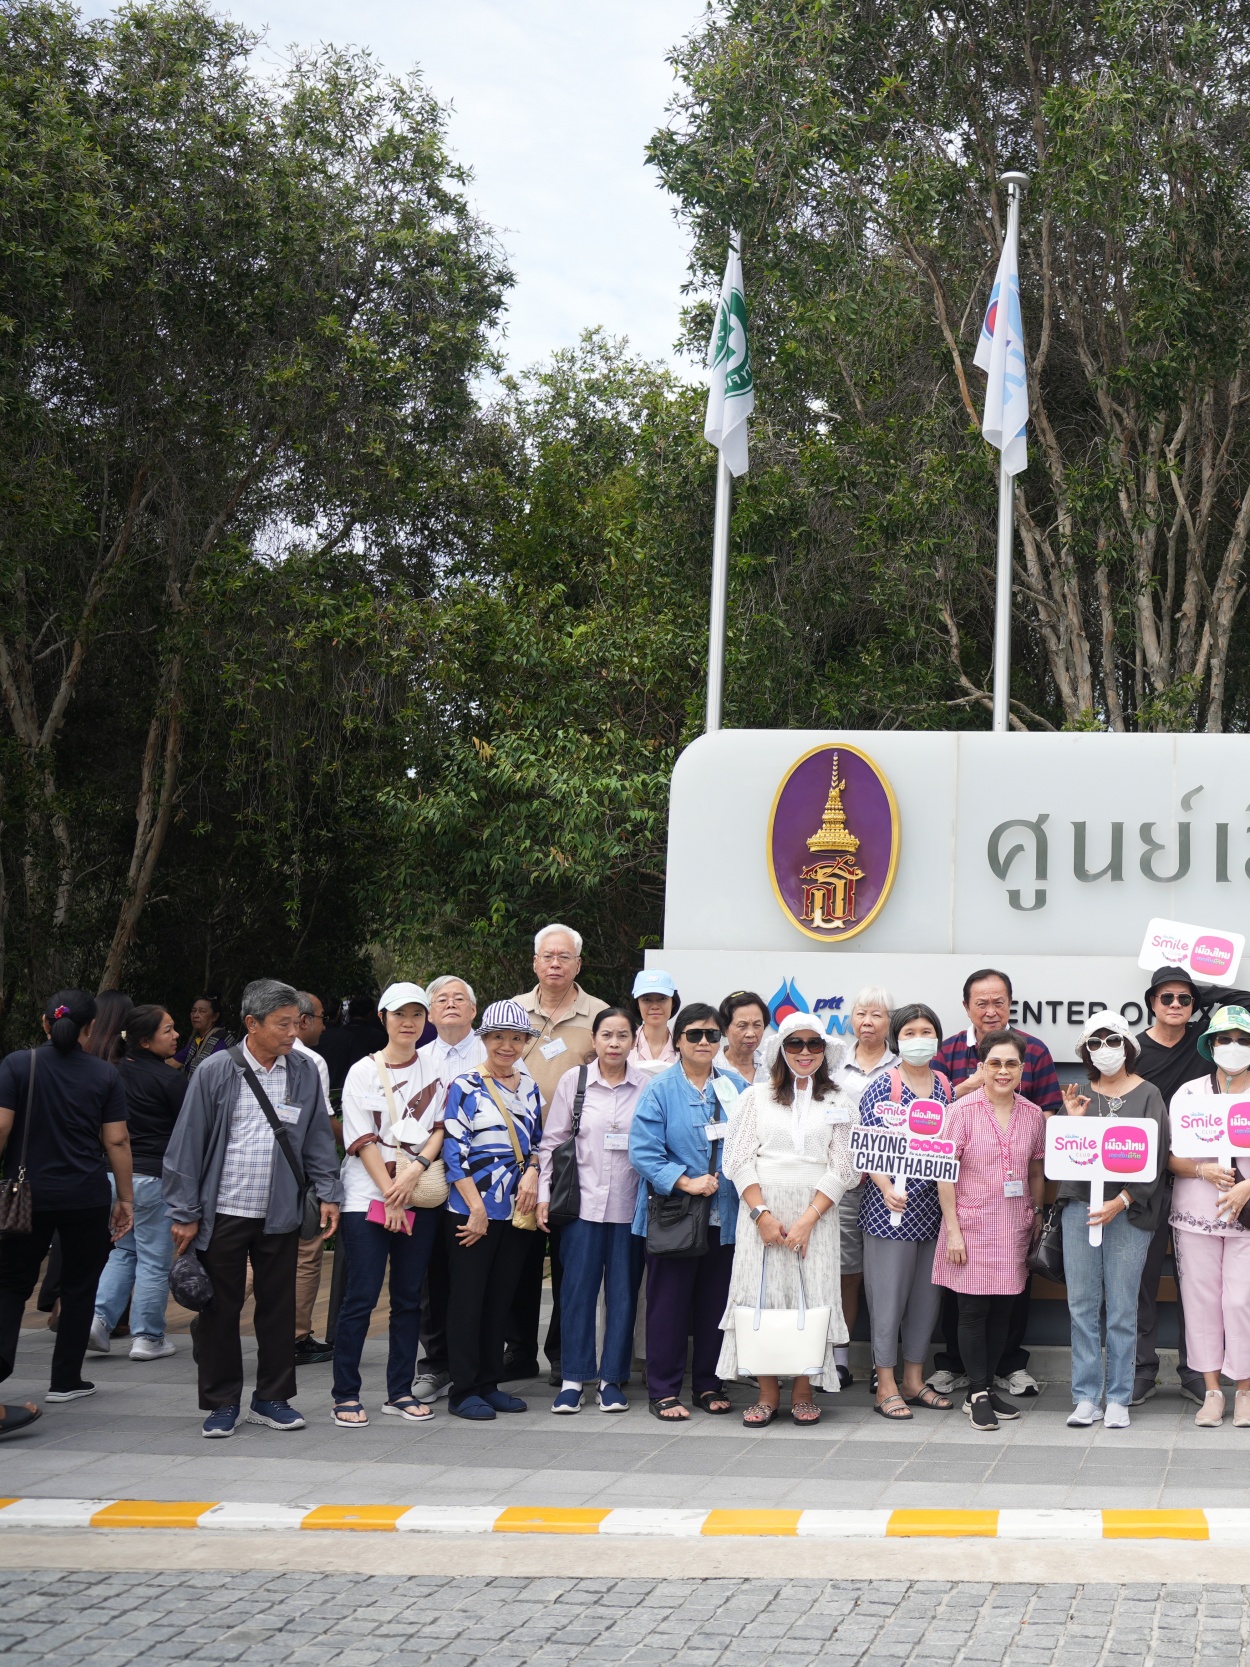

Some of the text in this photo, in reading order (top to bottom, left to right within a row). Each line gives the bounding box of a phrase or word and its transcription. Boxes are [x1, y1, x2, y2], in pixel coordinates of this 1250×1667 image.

[1152, 936, 1189, 950] Smile
[813, 996, 844, 1012] ptt
[1120, 1001, 1152, 1026] O
[876, 1104, 906, 1116] Smile
[1181, 1114, 1223, 1128] Smile
[850, 1132, 907, 1155] RAYONG
[1055, 1137, 1097, 1150] Smile
[1105, 1138, 1145, 1150] เมืองไทย
[856, 1152, 957, 1180] CHANTHABURI
